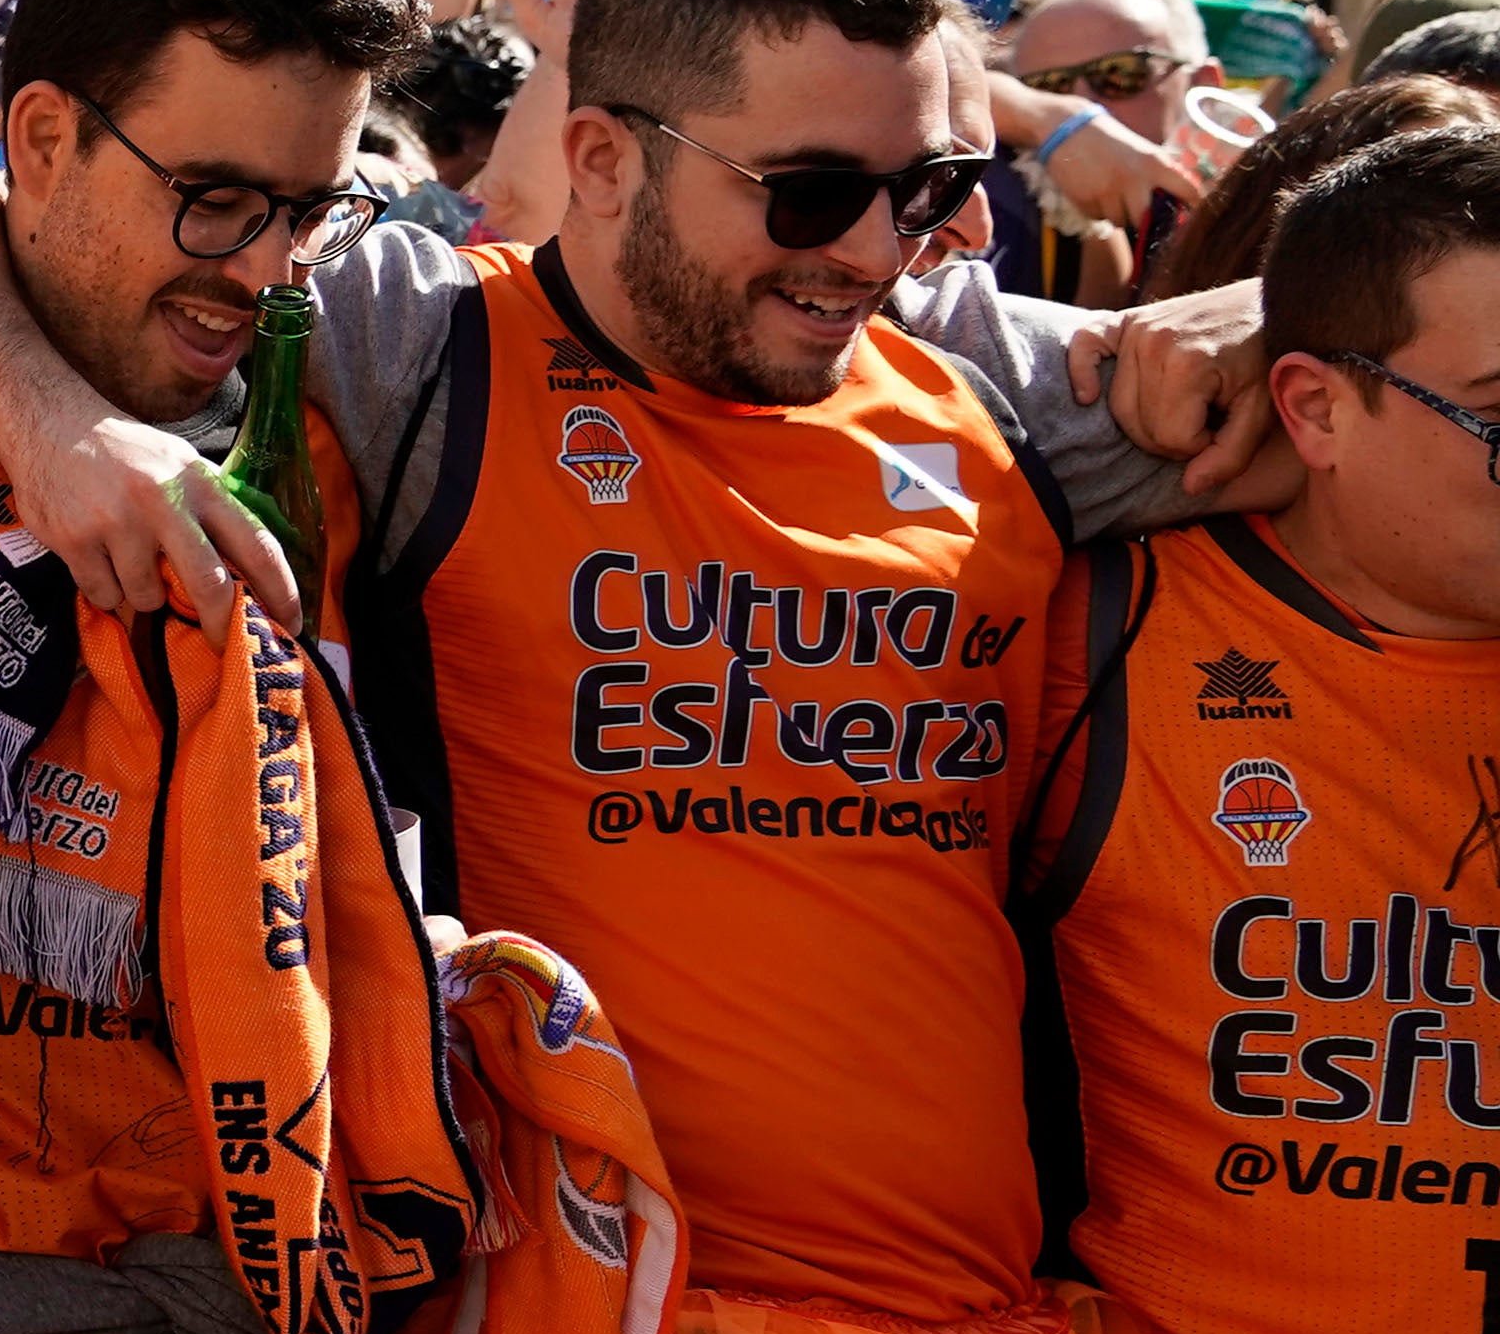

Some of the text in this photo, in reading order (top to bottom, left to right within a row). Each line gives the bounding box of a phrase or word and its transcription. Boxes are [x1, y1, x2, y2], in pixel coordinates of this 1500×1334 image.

[547, 375, 620, 393] luanv
[570, 550, 957, 671] Cultura
[571, 656, 1009, 786] Esfuerzo
[1197, 701, 1293, 721] luanvi
[80, 788, 120, 820] del
[1209, 892, 1500, 1006] Cult
[1209, 1009, 1500, 1129] Esfu
[211, 1079, 270, 1176] ENS
